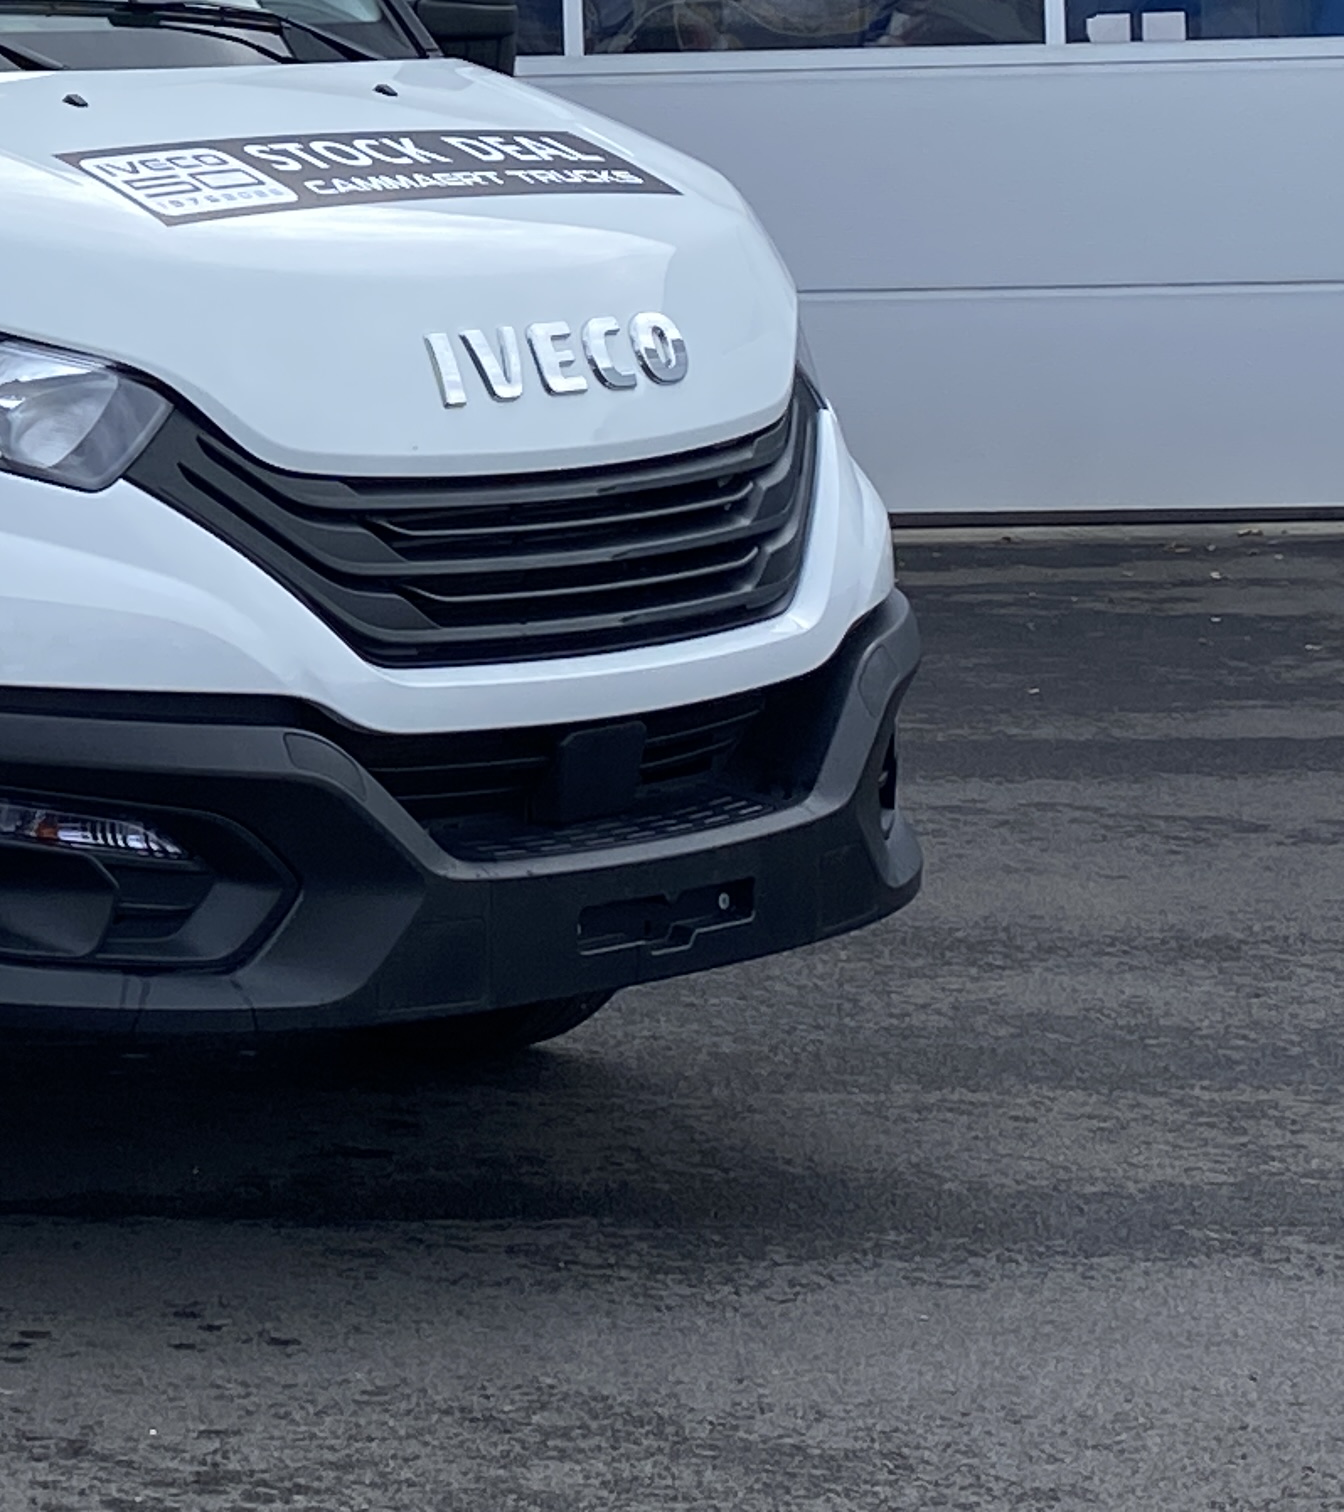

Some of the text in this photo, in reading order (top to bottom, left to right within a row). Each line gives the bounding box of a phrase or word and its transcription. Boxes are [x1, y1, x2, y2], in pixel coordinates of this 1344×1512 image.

[95, 154, 229, 177] IVECO
[243, 136, 606, 171] STOCK DEAL
[304, 169, 645, 195] CAMMAERT TRUCKS
[423, 312, 689, 409] IVECO
